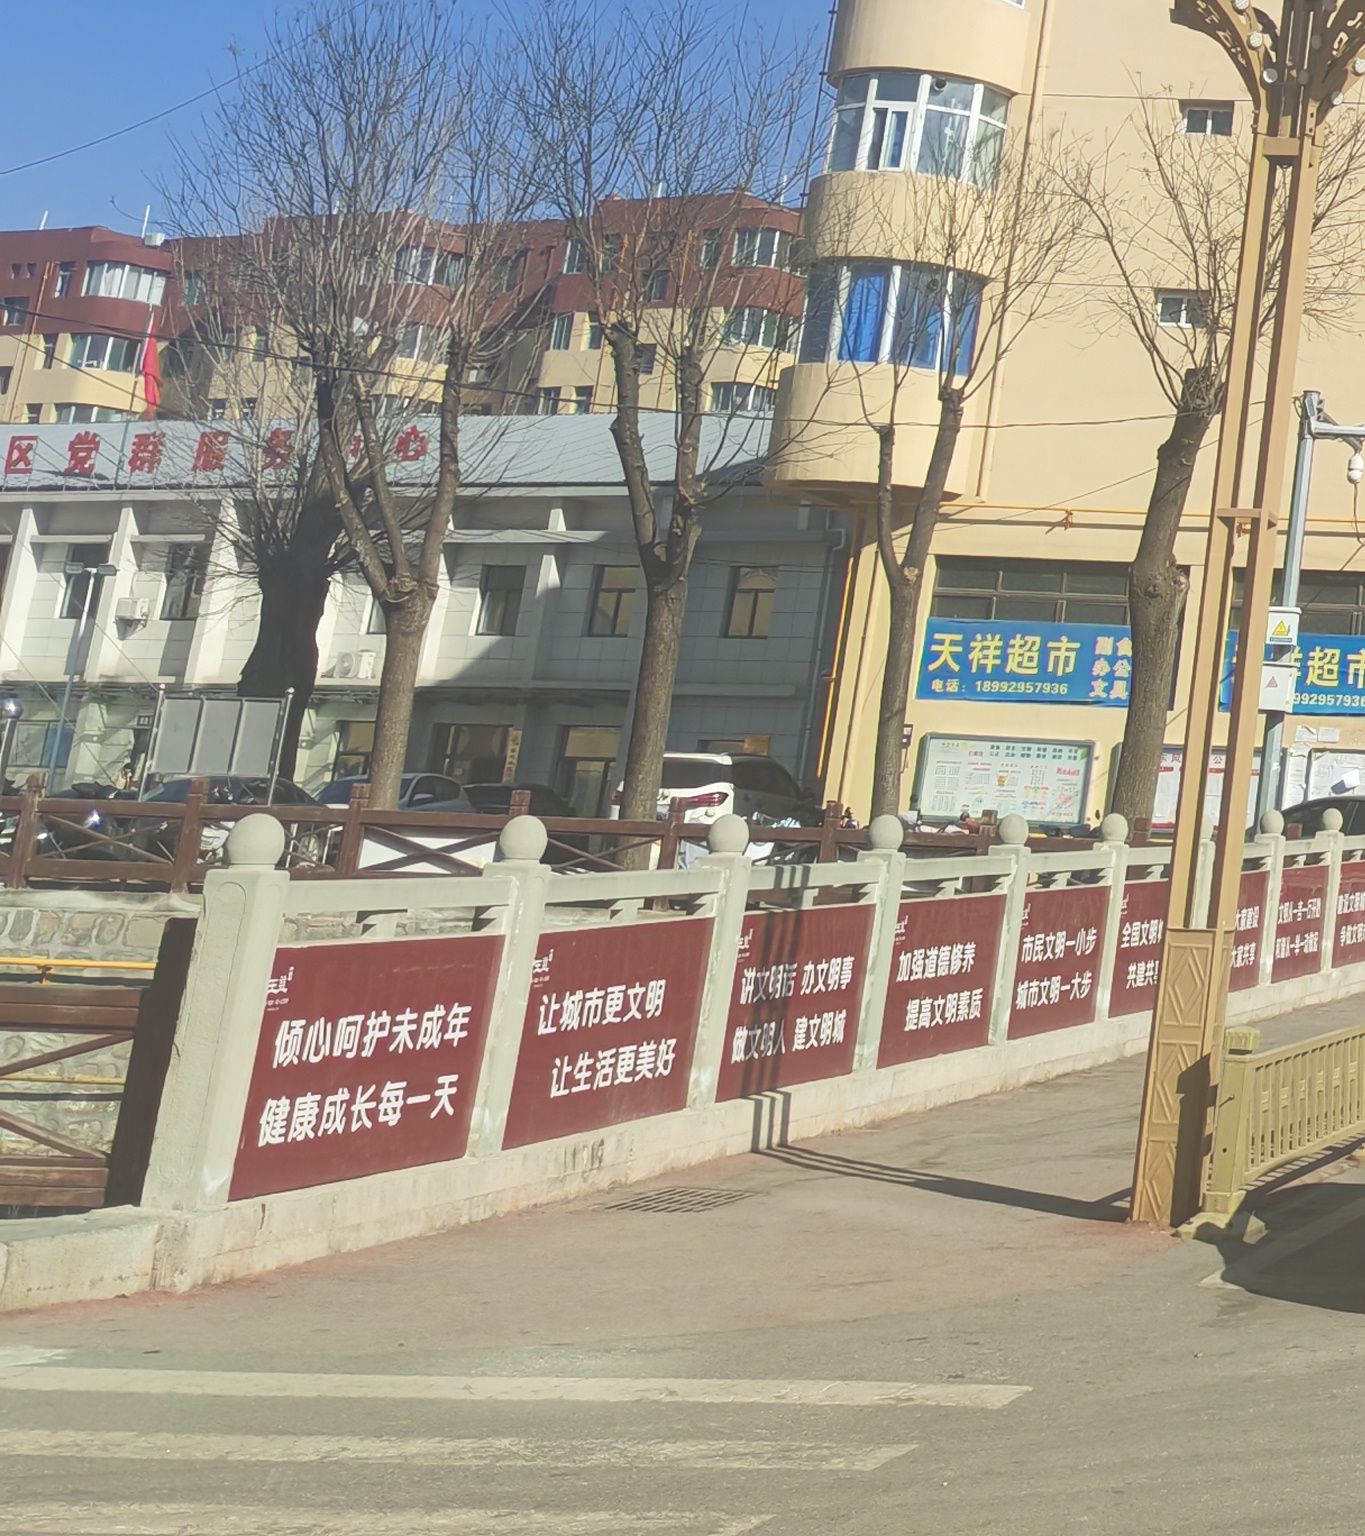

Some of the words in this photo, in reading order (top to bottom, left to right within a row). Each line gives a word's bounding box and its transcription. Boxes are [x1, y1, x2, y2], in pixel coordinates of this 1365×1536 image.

[928, 632, 1081, 677] 天祥超市
[975, 680, 1068, 695] 18992957936
[896, 942, 977, 983] 加强道德修养
[1021, 927, 1098, 964] 市民文明一小步
[799, 955, 855, 997] 办文明事
[1015, 970, 1093, 1011] 城市文明一大步
[537, 978, 667, 1036] 让城市更文明
[903, 987, 984, 1032] 提高文明素质
[272, 1001, 473, 1069] 倾心呵护未成年
[731, 1018, 786, 1064] 做文明人
[792, 1009, 847, 1053] 建文明城
[550, 1038, 677, 1099] 让生活更美好
[257, 1074, 460, 1148] 健康成长每一天
